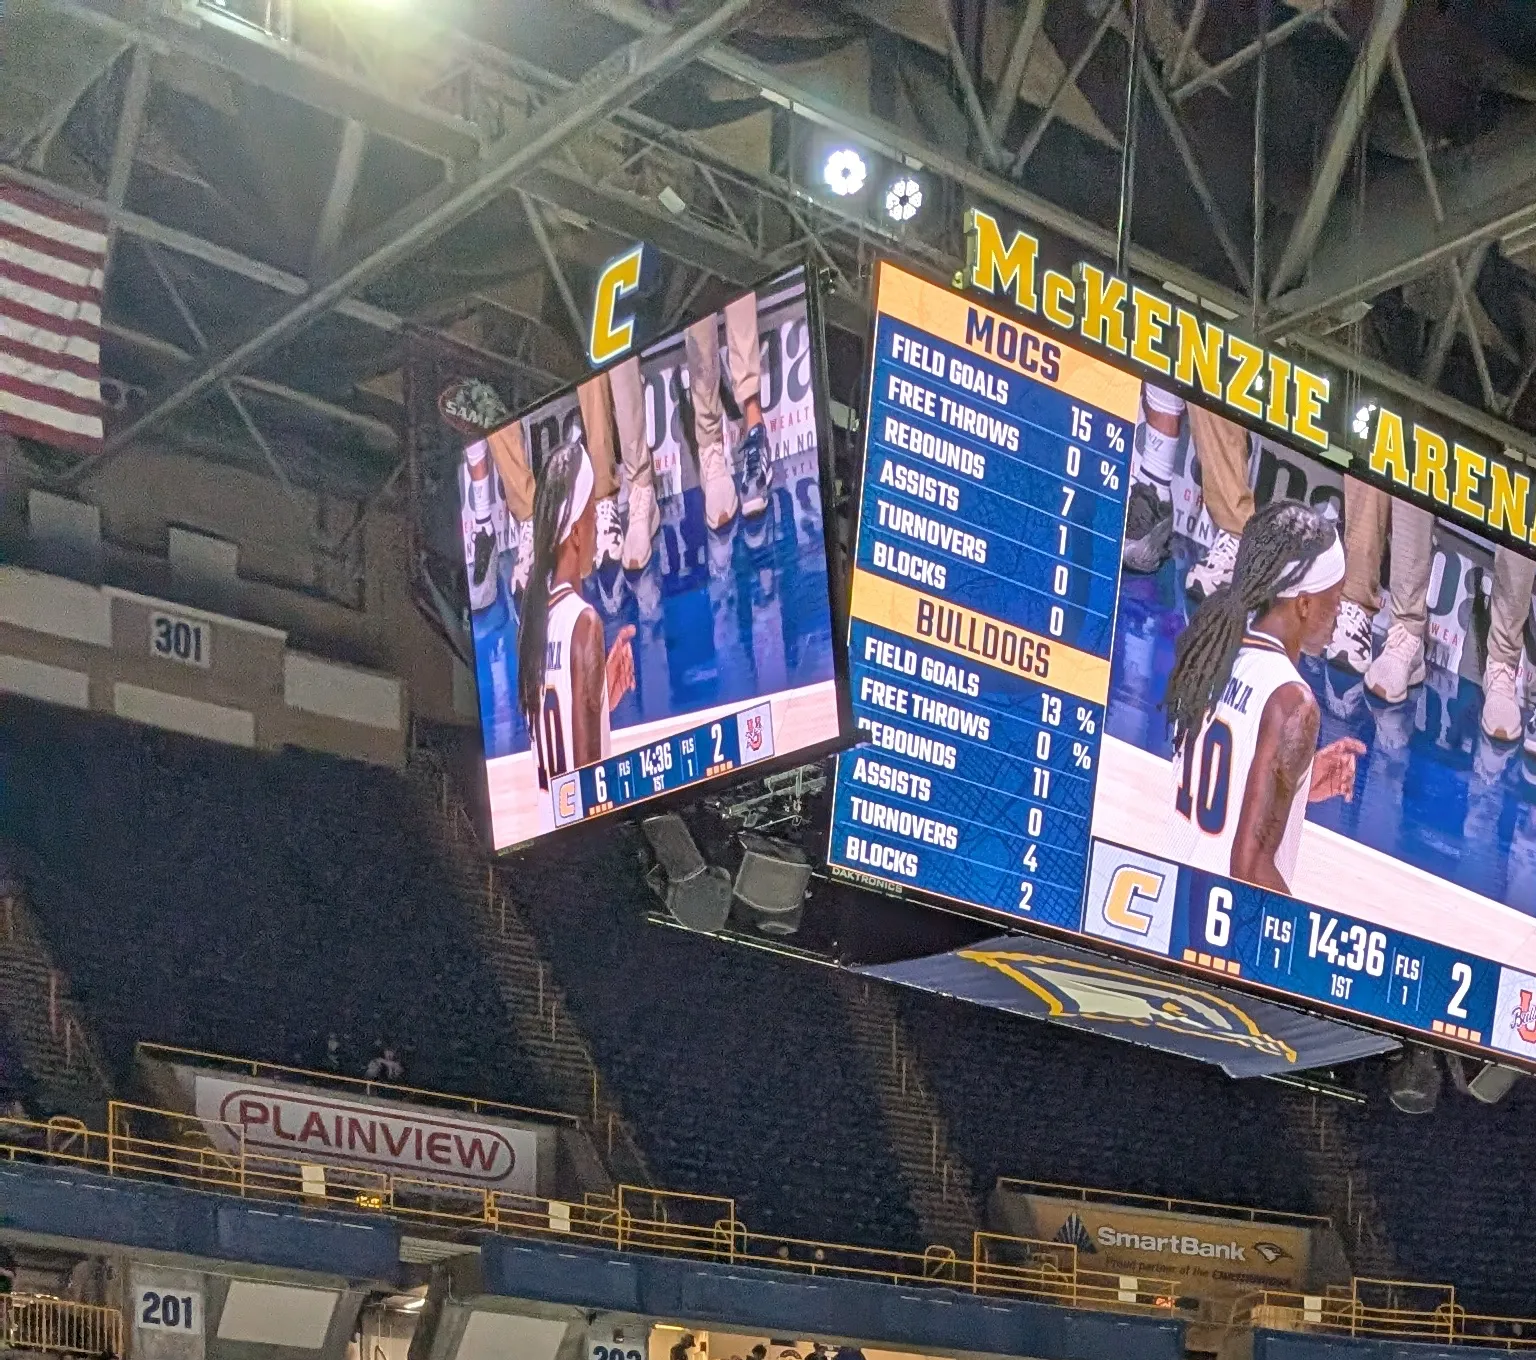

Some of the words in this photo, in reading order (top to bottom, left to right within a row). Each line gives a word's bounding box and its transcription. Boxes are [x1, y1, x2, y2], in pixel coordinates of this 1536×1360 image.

[588, 242, 645, 366] C
[965, 307, 1061, 383] MOCS
[971, 208, 1330, 451] McKENZIE
[888, 375, 936, 418] FREE
[939, 396, 1020, 452] THROWS
[1066, 446, 1080, 477] 0
[1100, 461, 1120, 491] %
[891, 333, 945, 378] FIELD
[949, 359, 1009, 405] GOALS
[1071, 407, 1093, 442] 15
[1106, 423, 1125, 453] %
[879, 459, 960, 512] ASSISTS
[1058, 525, 1067, 556] 1
[884, 417, 986, 480] REBOUNDS
[1060, 486, 1076, 517] 7
[873, 541, 947, 591] BLOCKS
[1050, 606, 1064, 637] 0
[877, 499, 987, 563] TURNOVERS
[1054, 565, 1069, 597] 0
[153, 617, 202, 664] 301
[916, 597, 1051, 679] BULLDOGS
[860, 677, 908, 716] FREE
[912, 693, 991, 742] THROWS
[1036, 731, 1051, 761] 0
[1072, 749, 1092, 770] %
[864, 636, 917, 677] FIELD
[921, 656, 981, 698] GOALS
[1041, 692, 1062, 727] 13
[1077, 706, 1096, 735] %
[558, 778, 576, 819] C
[594, 765, 608, 803] 6
[618, 759, 631, 776] FLS
[640, 742, 673, 779] 14:36
[681, 739, 695, 756] FLS
[711, 723, 724, 762] 2
[624, 781, 630, 799] 1
[687, 760, 693, 777] 1
[853, 758, 932, 803] ASSISTS
[1028, 807, 1043, 837] 0
[1032, 766, 1050, 799] 11
[845, 836, 919, 878] BLOCKS
[1019, 882, 1033, 911] 2
[850, 796, 959, 850] TURNOVERS
[1023, 844, 1038, 873] 4
[832, 867, 904, 894] DAKTRONICS
[1102, 864, 1166, 936] C
[1204, 886, 1233, 947] 6
[1265, 915, 1291, 945] FLS
[1307, 912, 1387, 977] 14:36
[1395, 953, 1420, 981] FLS
[1447, 962, 1473, 1019] 2
[1273, 948, 1281, 969] 1
[1331, 973, 1354, 1000] 1ST
[1401, 985, 1408, 1006] 1
[239, 1099, 500, 1172] PLAINVIEW
[1098, 1226, 1246, 1262] SmartBank
[141, 1291, 194, 1330] 201
